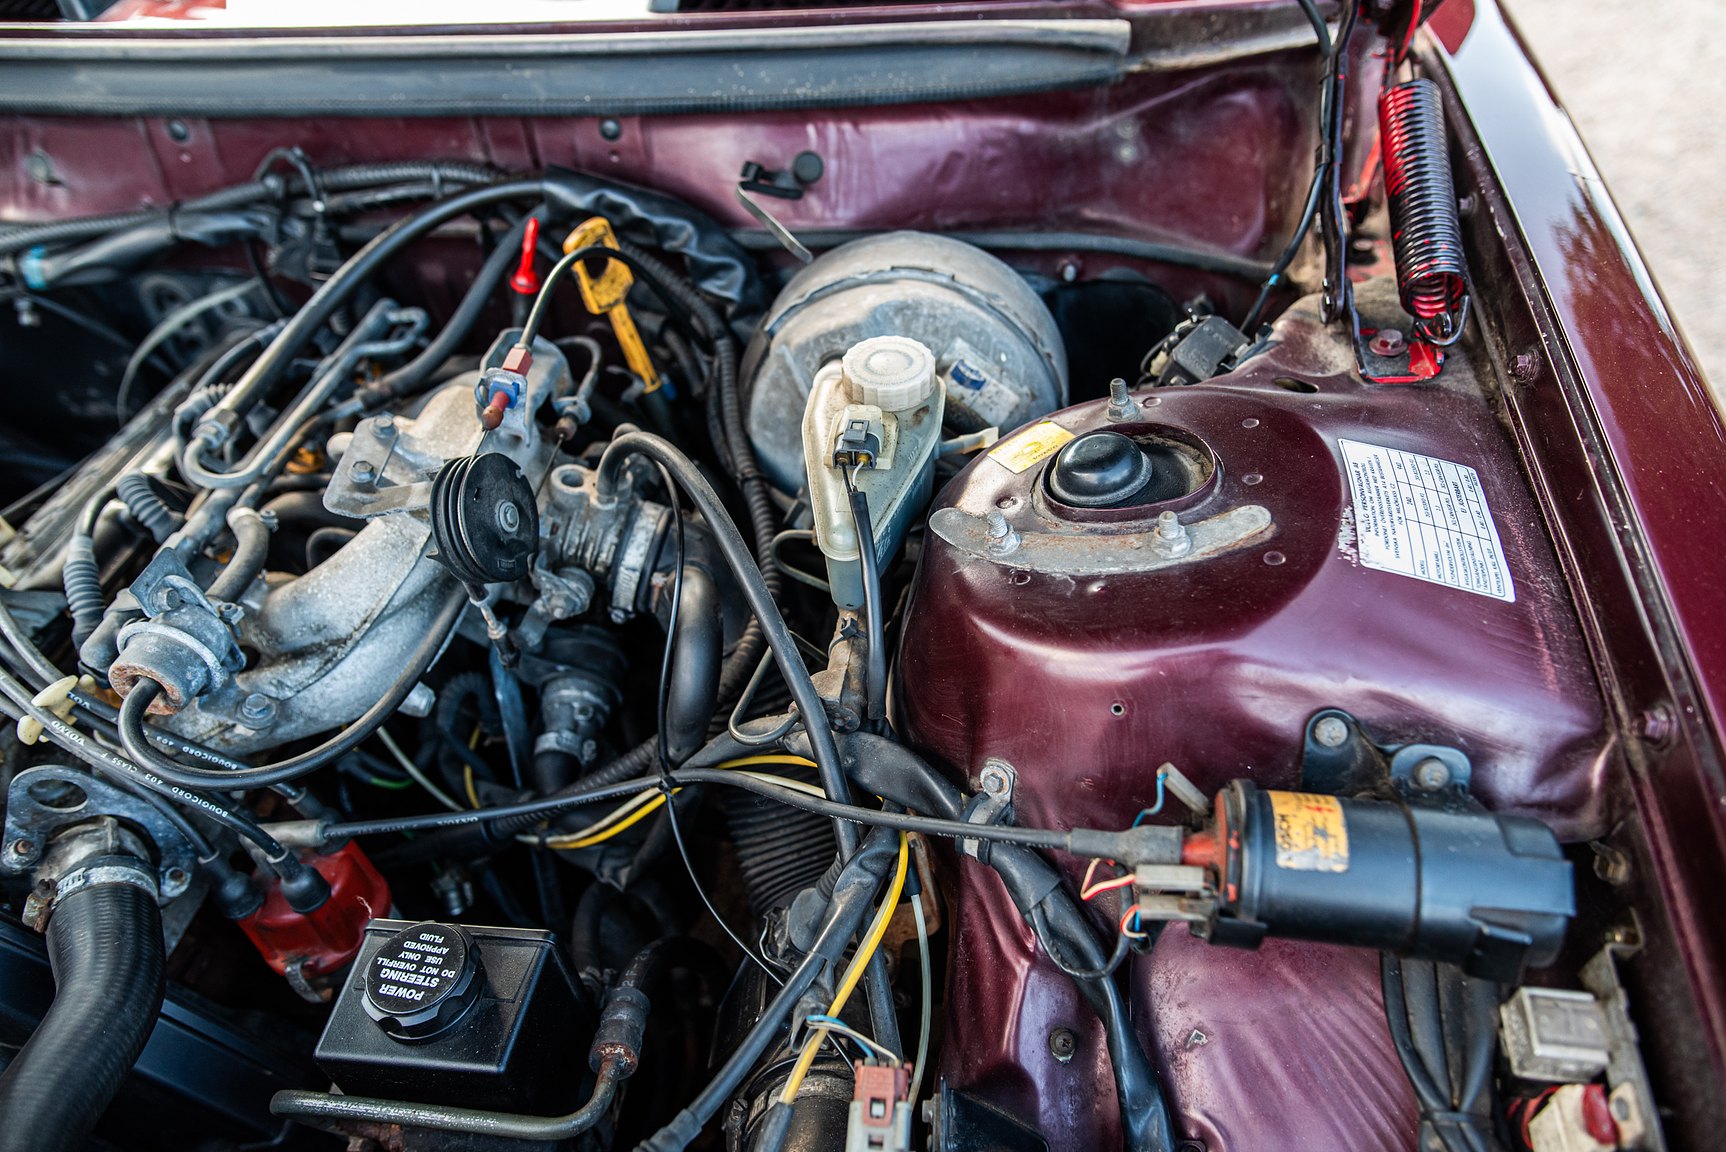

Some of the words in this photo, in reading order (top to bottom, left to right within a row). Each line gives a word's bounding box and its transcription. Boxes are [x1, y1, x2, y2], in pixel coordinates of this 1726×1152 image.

[1354, 469, 1368, 510] PERSONVAGNAR
[67, 691, 91, 709] VOL
[51, 720, 85, 746] VOLVO
[156, 736, 174, 746] 403
[112, 757, 137, 773] CLASS
[182, 746, 238, 770] BOUGICORD
[145, 773, 164, 785] 403
[172, 786, 228, 818] BOUGICORD
[419, 932, 445, 944] FLUID
[403, 940, 450, 955] APPROVED
[398, 950, 421, 961] ONLY
[424, 955, 443, 965] USE
[377, 957, 417, 971] OVERFILL
[420, 965, 440, 976] NOT
[380, 968, 440, 988] STEERING
[441, 969, 456, 979] DO
[379, 983, 425, 1001] POWER
